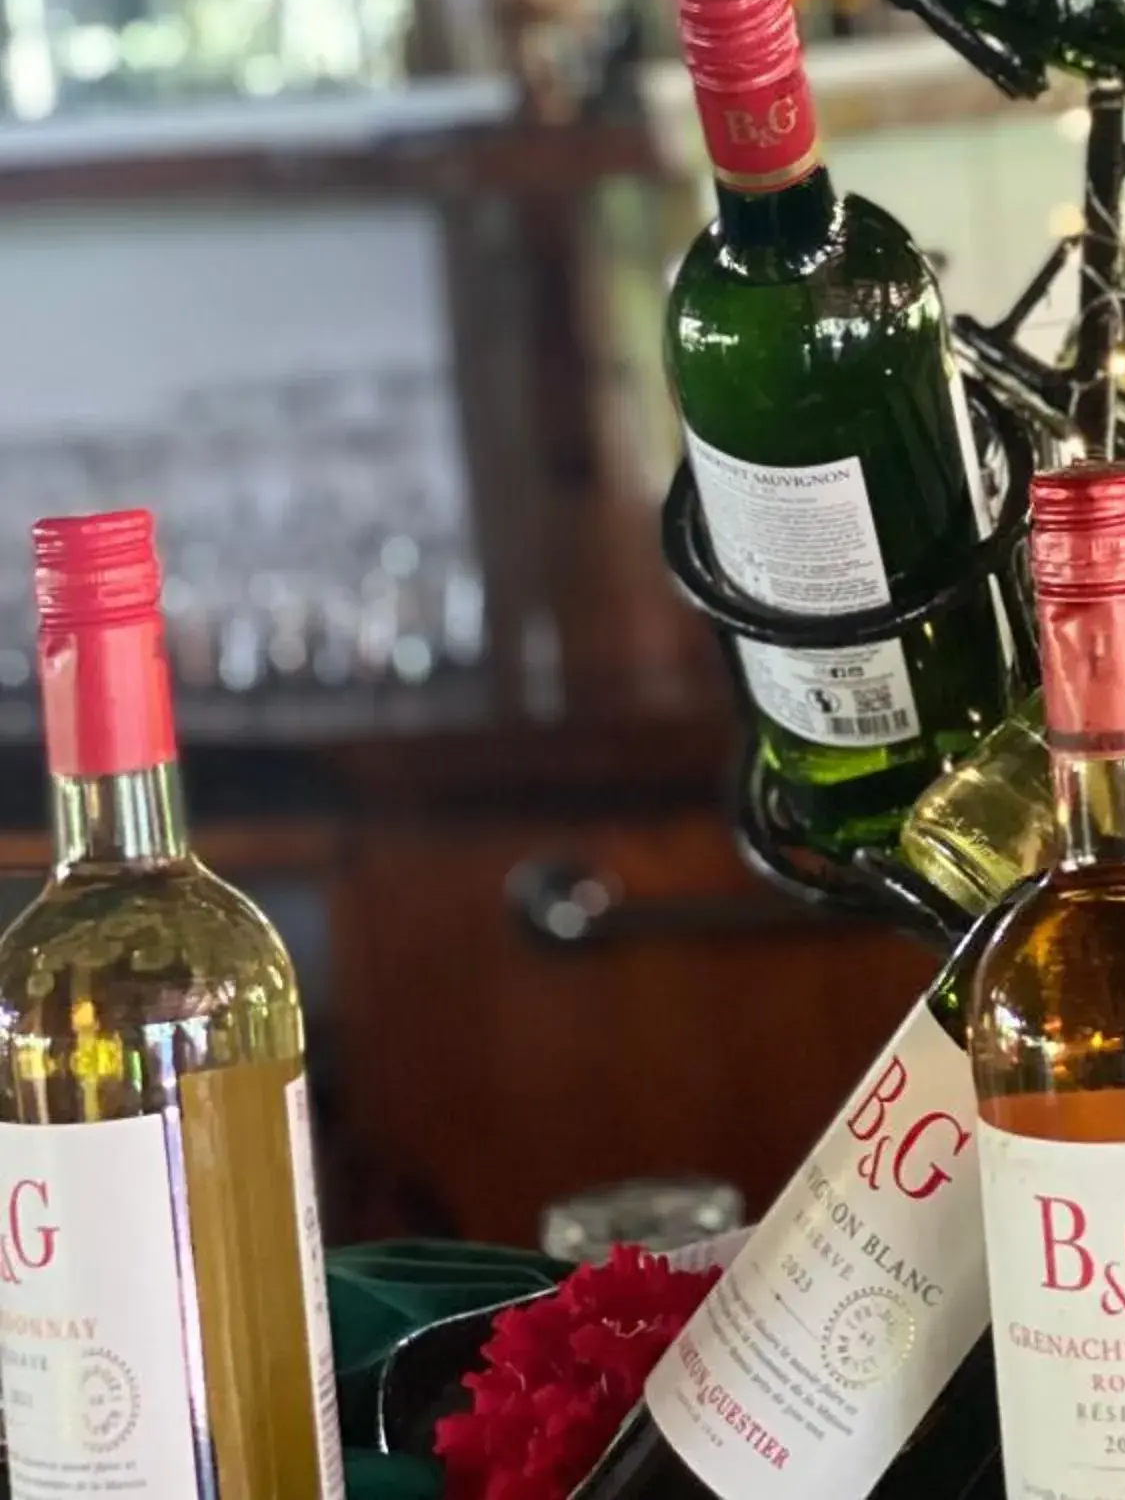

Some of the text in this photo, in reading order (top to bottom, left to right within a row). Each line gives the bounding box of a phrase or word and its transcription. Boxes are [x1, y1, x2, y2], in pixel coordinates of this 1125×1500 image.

[723, 97, 798, 148] B&G
[754, 468, 850, 488] SAUVIGNON
[848, 1055, 972, 1200] B&G
[861, 1230, 945, 1308] BLANC
